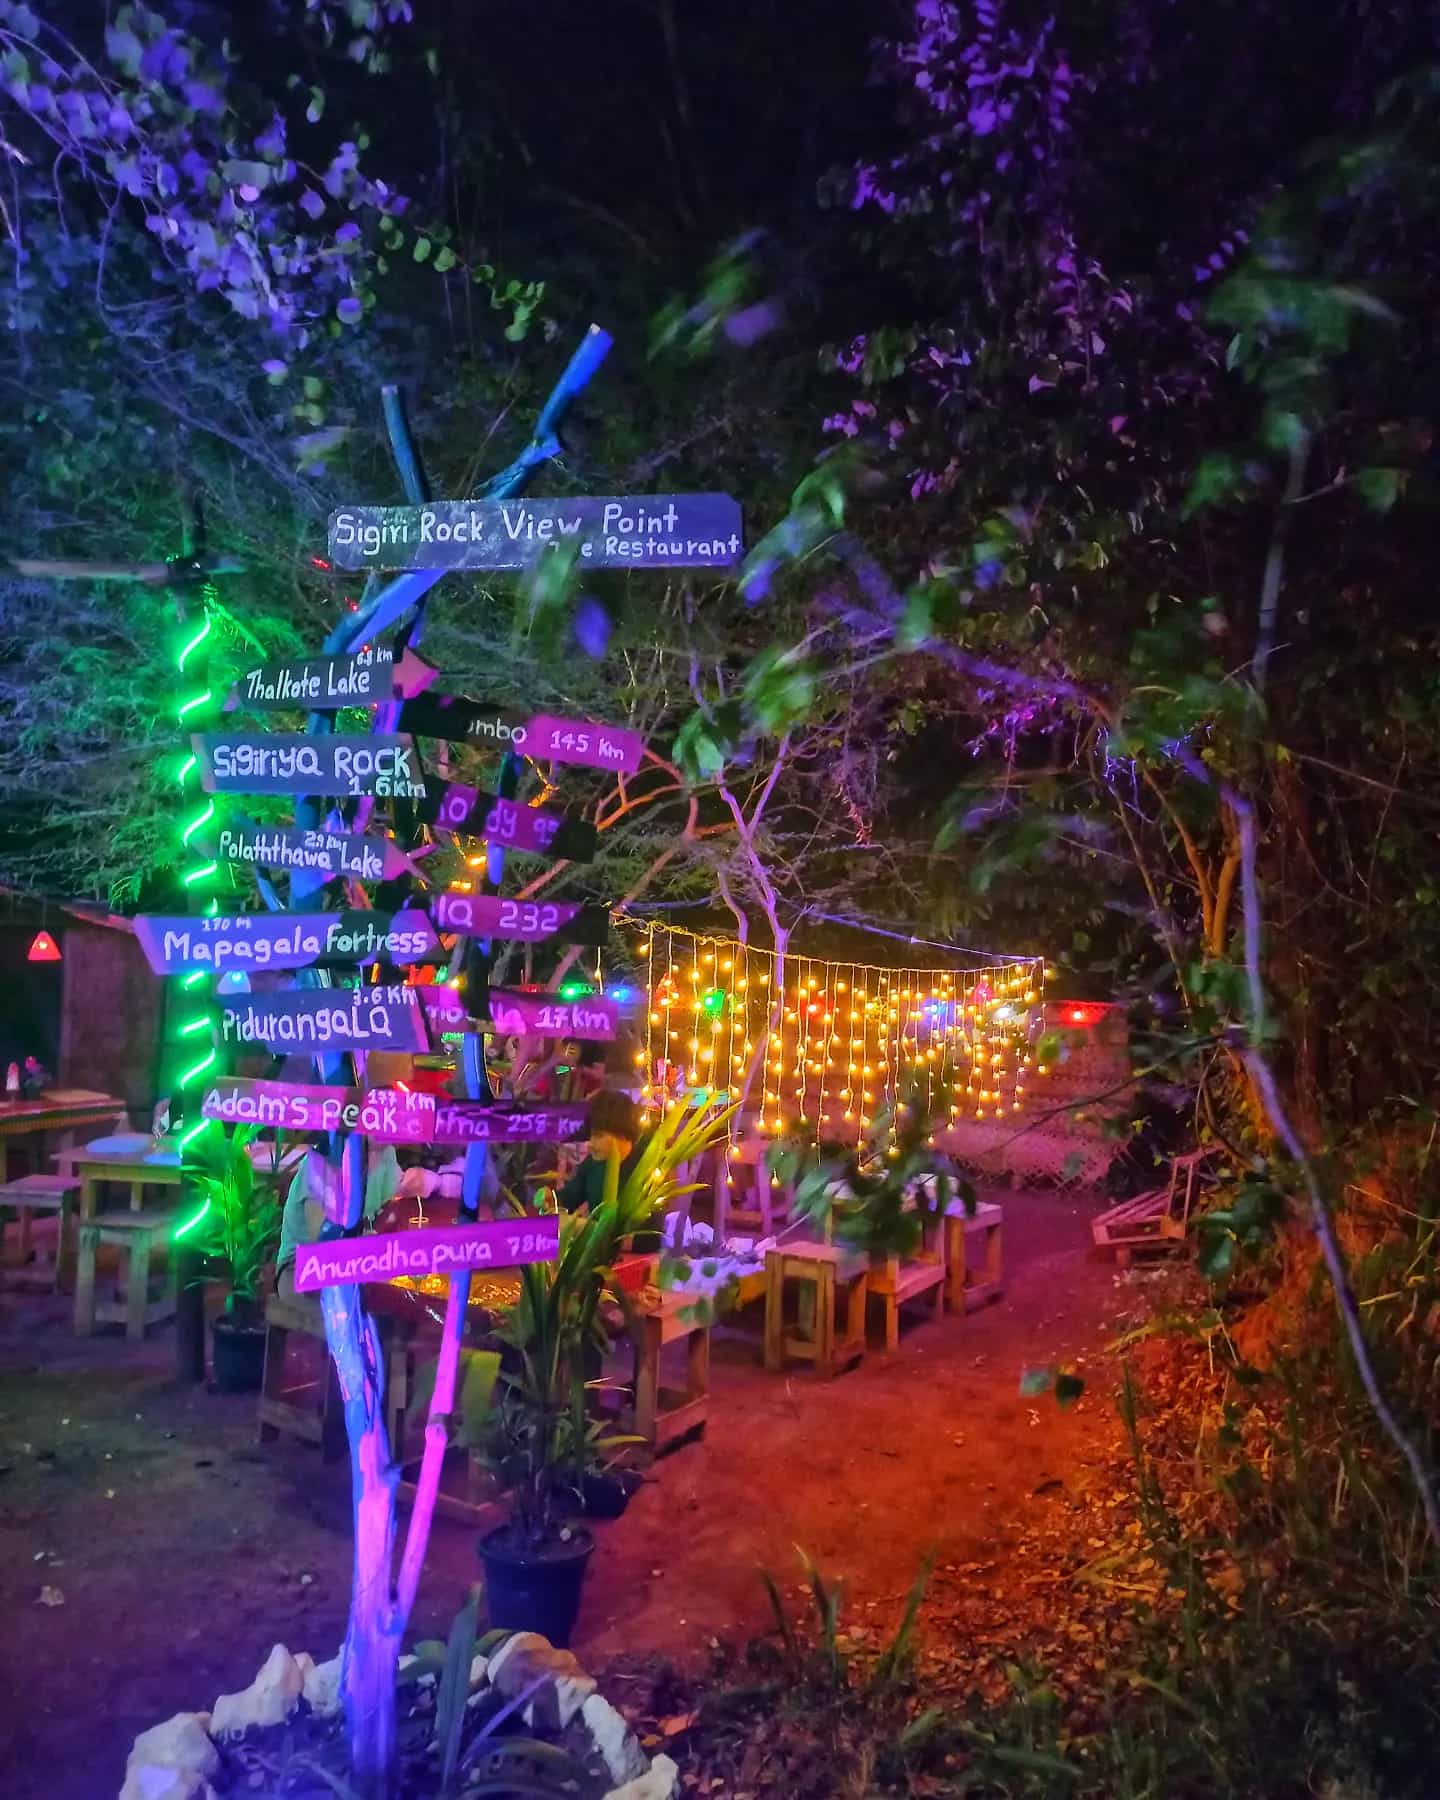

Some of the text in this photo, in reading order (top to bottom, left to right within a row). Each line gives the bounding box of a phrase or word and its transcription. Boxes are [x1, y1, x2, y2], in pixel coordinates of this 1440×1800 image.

[335, 503, 679, 556] Sigiri Rock View Point
[605, 533, 740, 558] Restaurant
[246, 661, 371, 701] Thalkote Lake
[550, 730, 590, 753] 145
[340, 841, 384, 879] Lake
[500, 900, 558, 932] 232
[163, 925, 321, 969] Mapagala
[299, 1239, 492, 1285] Anuradhapura
